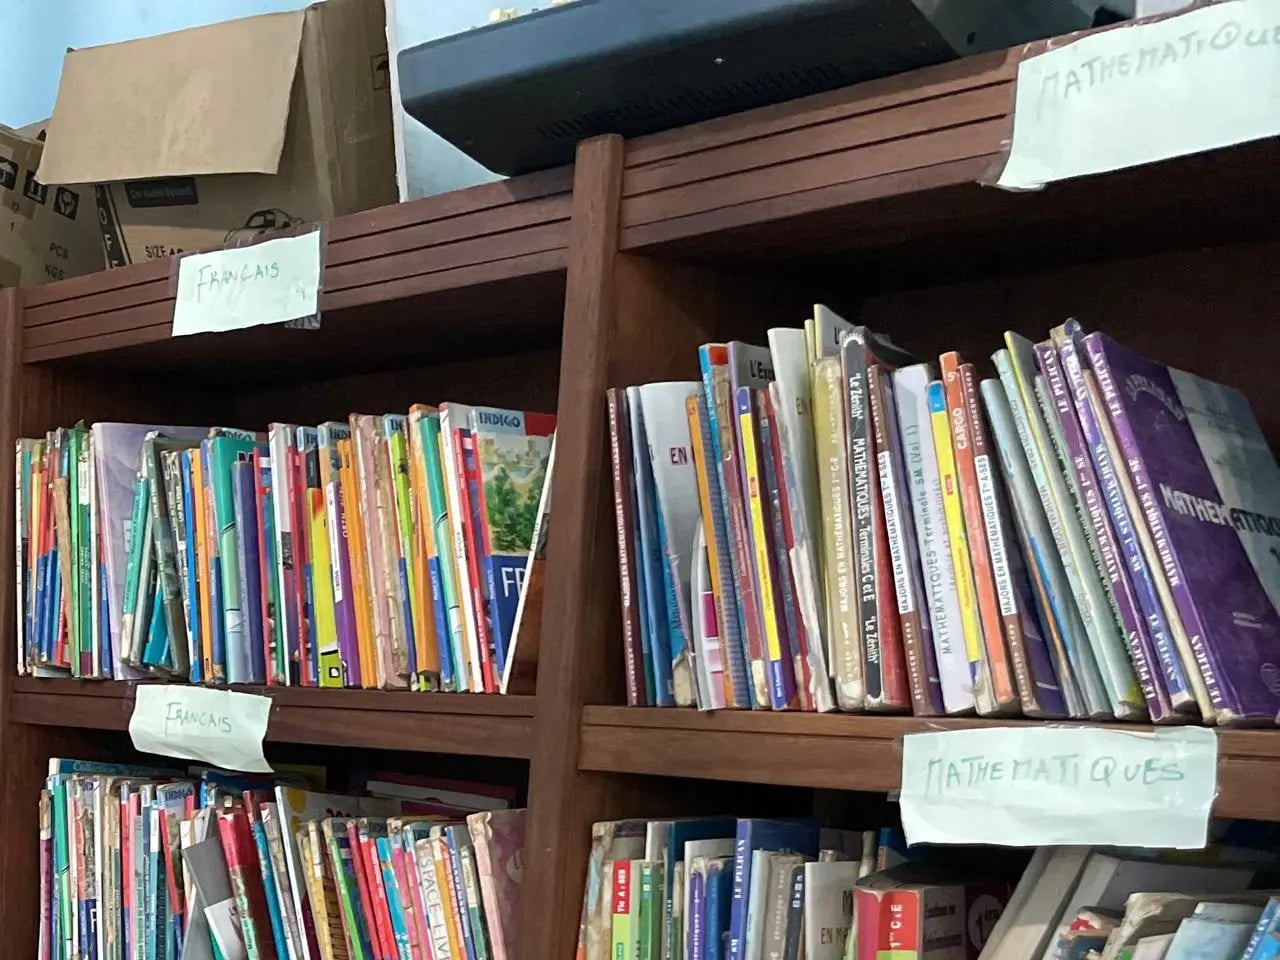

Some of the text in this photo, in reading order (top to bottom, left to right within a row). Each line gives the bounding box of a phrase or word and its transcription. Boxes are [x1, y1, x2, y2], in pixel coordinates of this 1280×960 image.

[49, 242, 69, 260] PCS
[479, 411, 520, 428] INDIGO
[952, 407, 967, 449] CARGO
[852, 437, 870, 519] MATHEMATIQUES
[917, 490, 934, 545] Terminale
[1139, 490, 1181, 586] MATHEMATIQUES
[858, 527, 873, 573] Terminales
[836, 561, 850, 611] MAJORS EN
[894, 563, 908, 611] MAJORS EN
[925, 549, 952, 654] MATHEMATIQUES
[995, 565, 1012, 613] MAJORS EN
[1189, 634, 1215, 685] PELICAN
[926, 753, 1185, 796] MATHEMATIQUES
